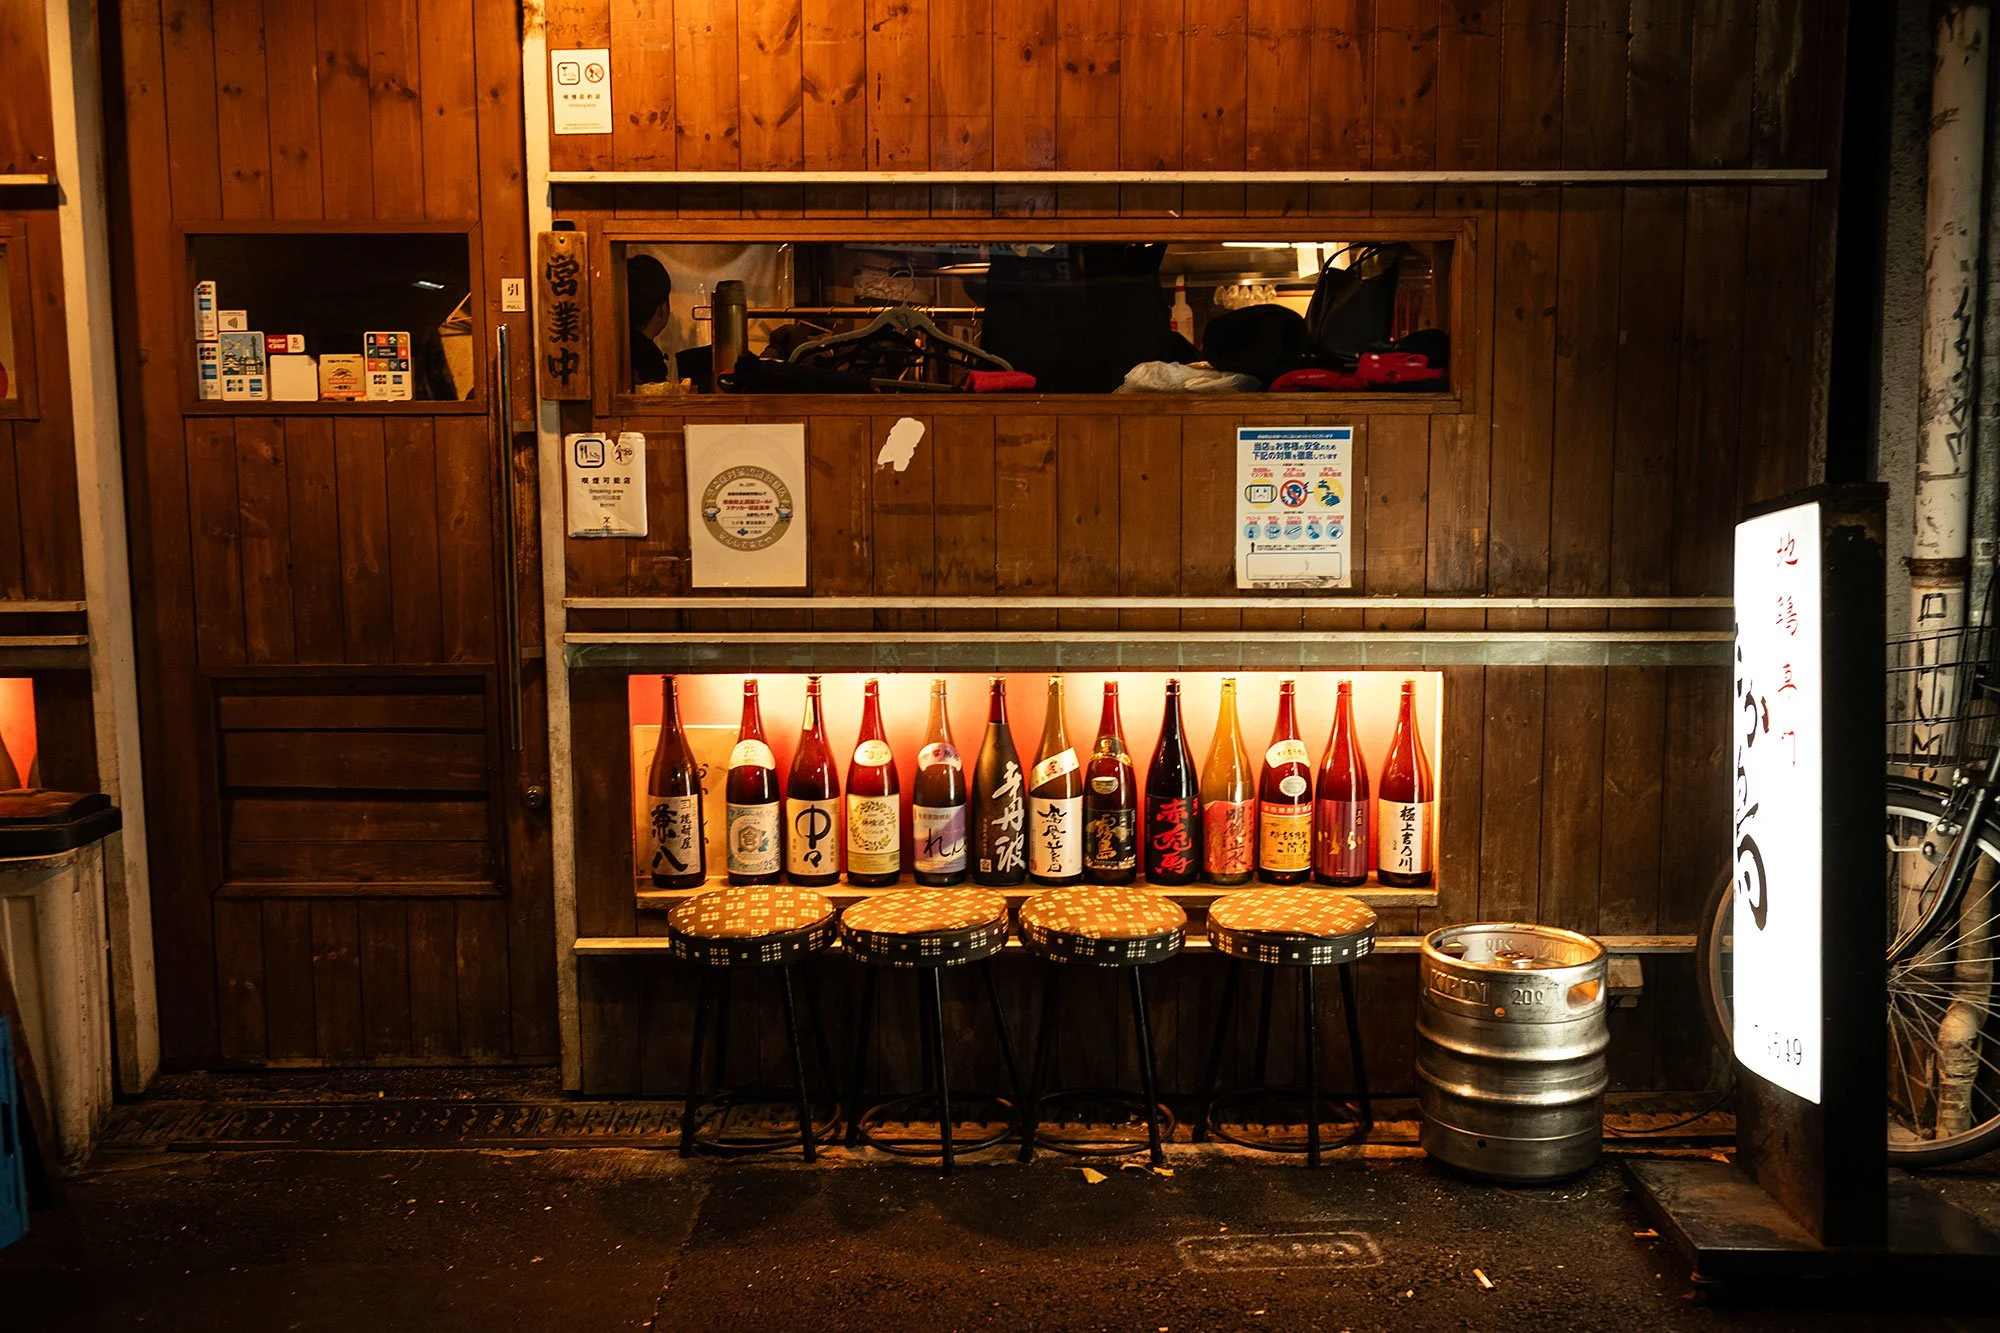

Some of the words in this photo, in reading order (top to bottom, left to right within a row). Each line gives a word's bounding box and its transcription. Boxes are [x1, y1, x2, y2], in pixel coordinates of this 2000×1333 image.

[507, 283, 519, 296] 引
[545, 254, 581, 388] 営業中
[1253, 441, 1337, 451] 当店はお客様の安全のため
[581, 477, 631, 485] 喫煙可能店
[650, 803, 689, 872] 兼八
[795, 804, 832, 868] 中々
[923, 828, 967, 858] れん
[991, 760, 1026, 873] 辛丹波
[1095, 813, 1118, 860] 霧島
[1153, 798, 1194, 874] 赤兎馬
[1398, 805, 1416, 872] 極上吉乃川
[1430, 969, 1489, 1005] KIRIN
